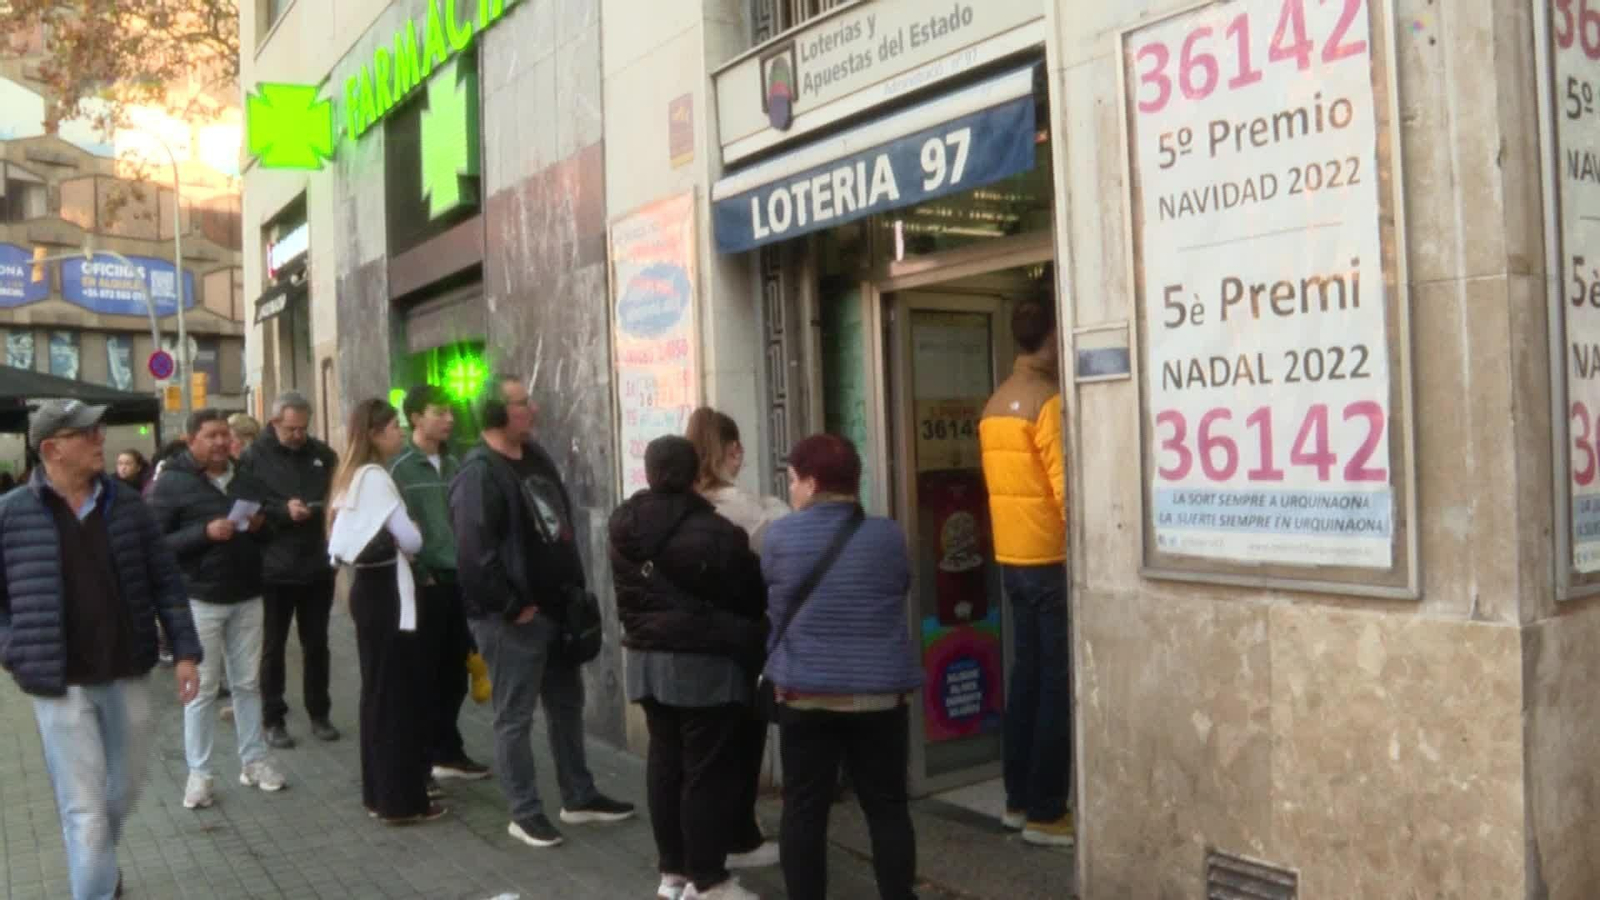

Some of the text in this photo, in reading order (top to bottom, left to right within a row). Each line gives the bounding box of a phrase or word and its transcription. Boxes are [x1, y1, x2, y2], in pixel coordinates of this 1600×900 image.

[803, 3, 973, 96] Apuestas del Estado
[866, 13, 876, 39] y
[1136, 0, 1368, 114] 36142
[344, 0, 503, 140] FARMAC
[1567, 75, 1594, 120] 5º
[1159, 92, 1354, 169] 5º Premio
[752, 127, 972, 240] LOTERIA 97
[1158, 156, 1361, 220] NAVIDAD 2022
[1163, 256, 1361, 329] 5è Premi
[1162, 344, 1371, 391] NADAL 2022
[921, 419, 979, 441] 3614
[1155, 400, 1388, 482] 36142
[1173, 493, 1371, 510] LA SORT SEMPRE A URQUINAONA
[1219, 515, 1271, 530] SIEMPRE
[1294, 518, 1384, 533] URQUINAONA
